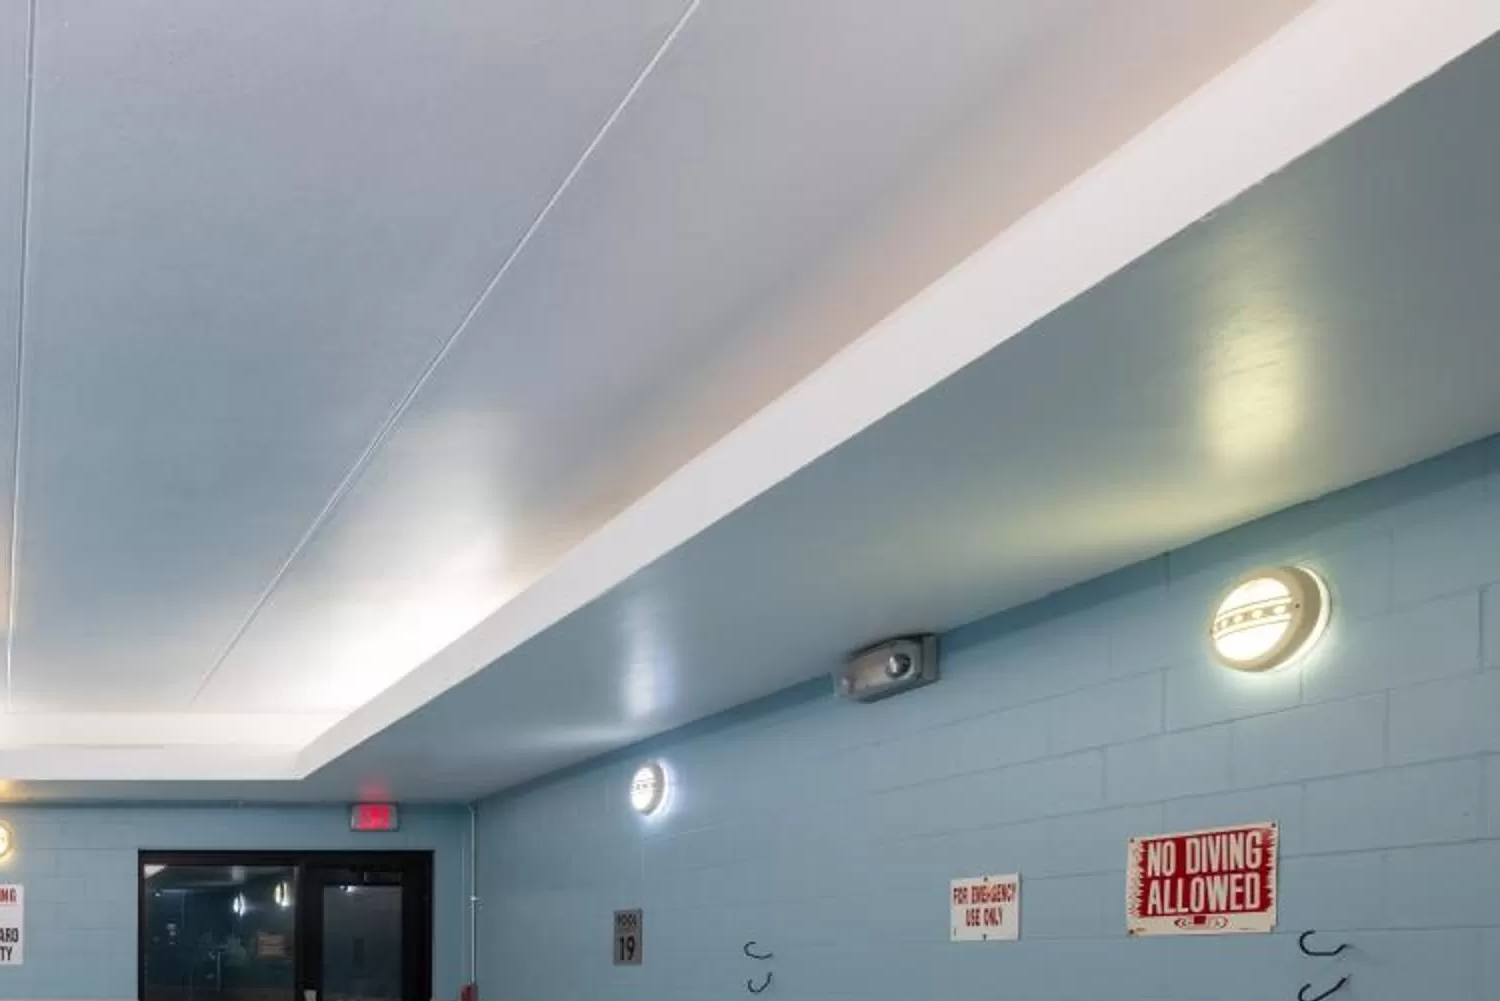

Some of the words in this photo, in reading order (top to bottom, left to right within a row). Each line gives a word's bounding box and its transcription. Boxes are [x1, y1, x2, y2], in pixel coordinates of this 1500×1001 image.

[1147, 840, 1176, 878] NO
[1185, 830, 1262, 875] DIVING
[1148, 872, 1261, 915] ALLOWED
[966, 908, 980, 926] USE
[984, 907, 1003, 926] ONLY
[619, 935, 636, 961] 19
